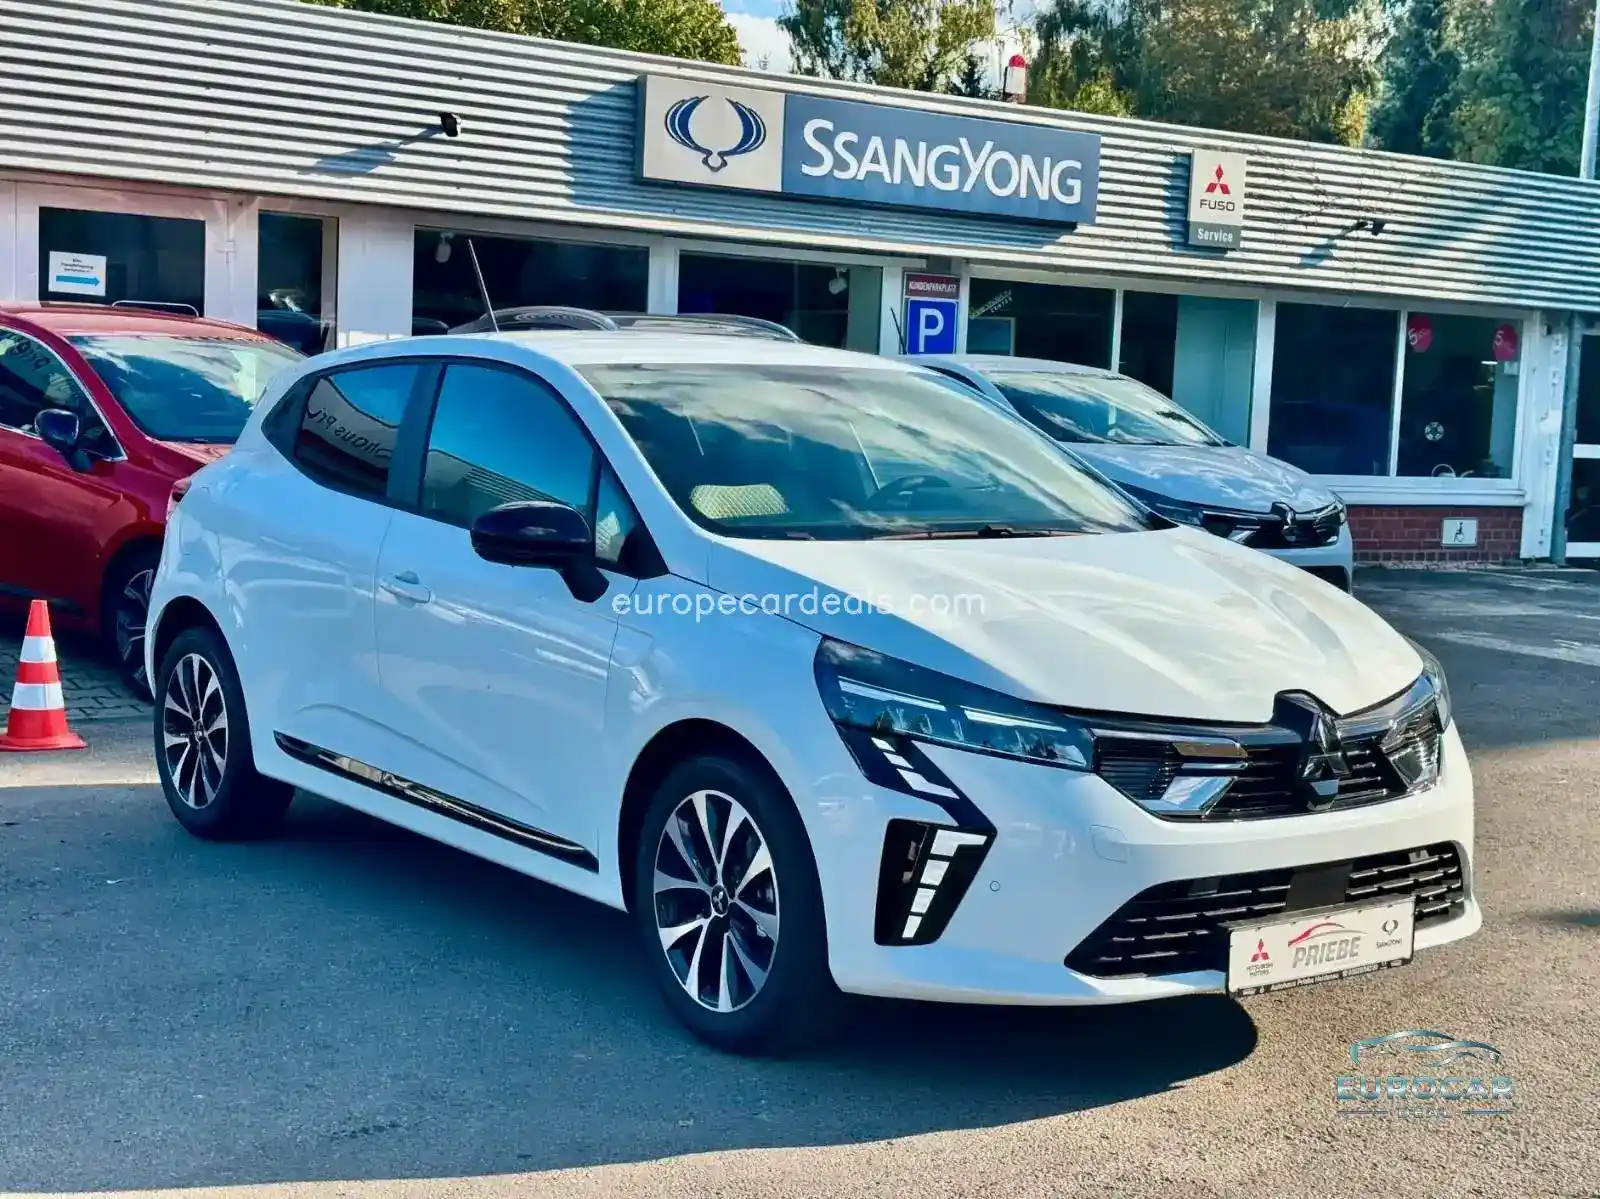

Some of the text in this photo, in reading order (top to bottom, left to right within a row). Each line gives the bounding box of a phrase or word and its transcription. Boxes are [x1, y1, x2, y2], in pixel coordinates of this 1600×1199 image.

[801, 118, 1083, 205] SSANGYONG
[1199, 199, 1235, 212] FUSO
[1197, 228, 1234, 242] Service
[918, 307, 945, 353] P
[1292, 936, 1362, 968] PRIEBE
